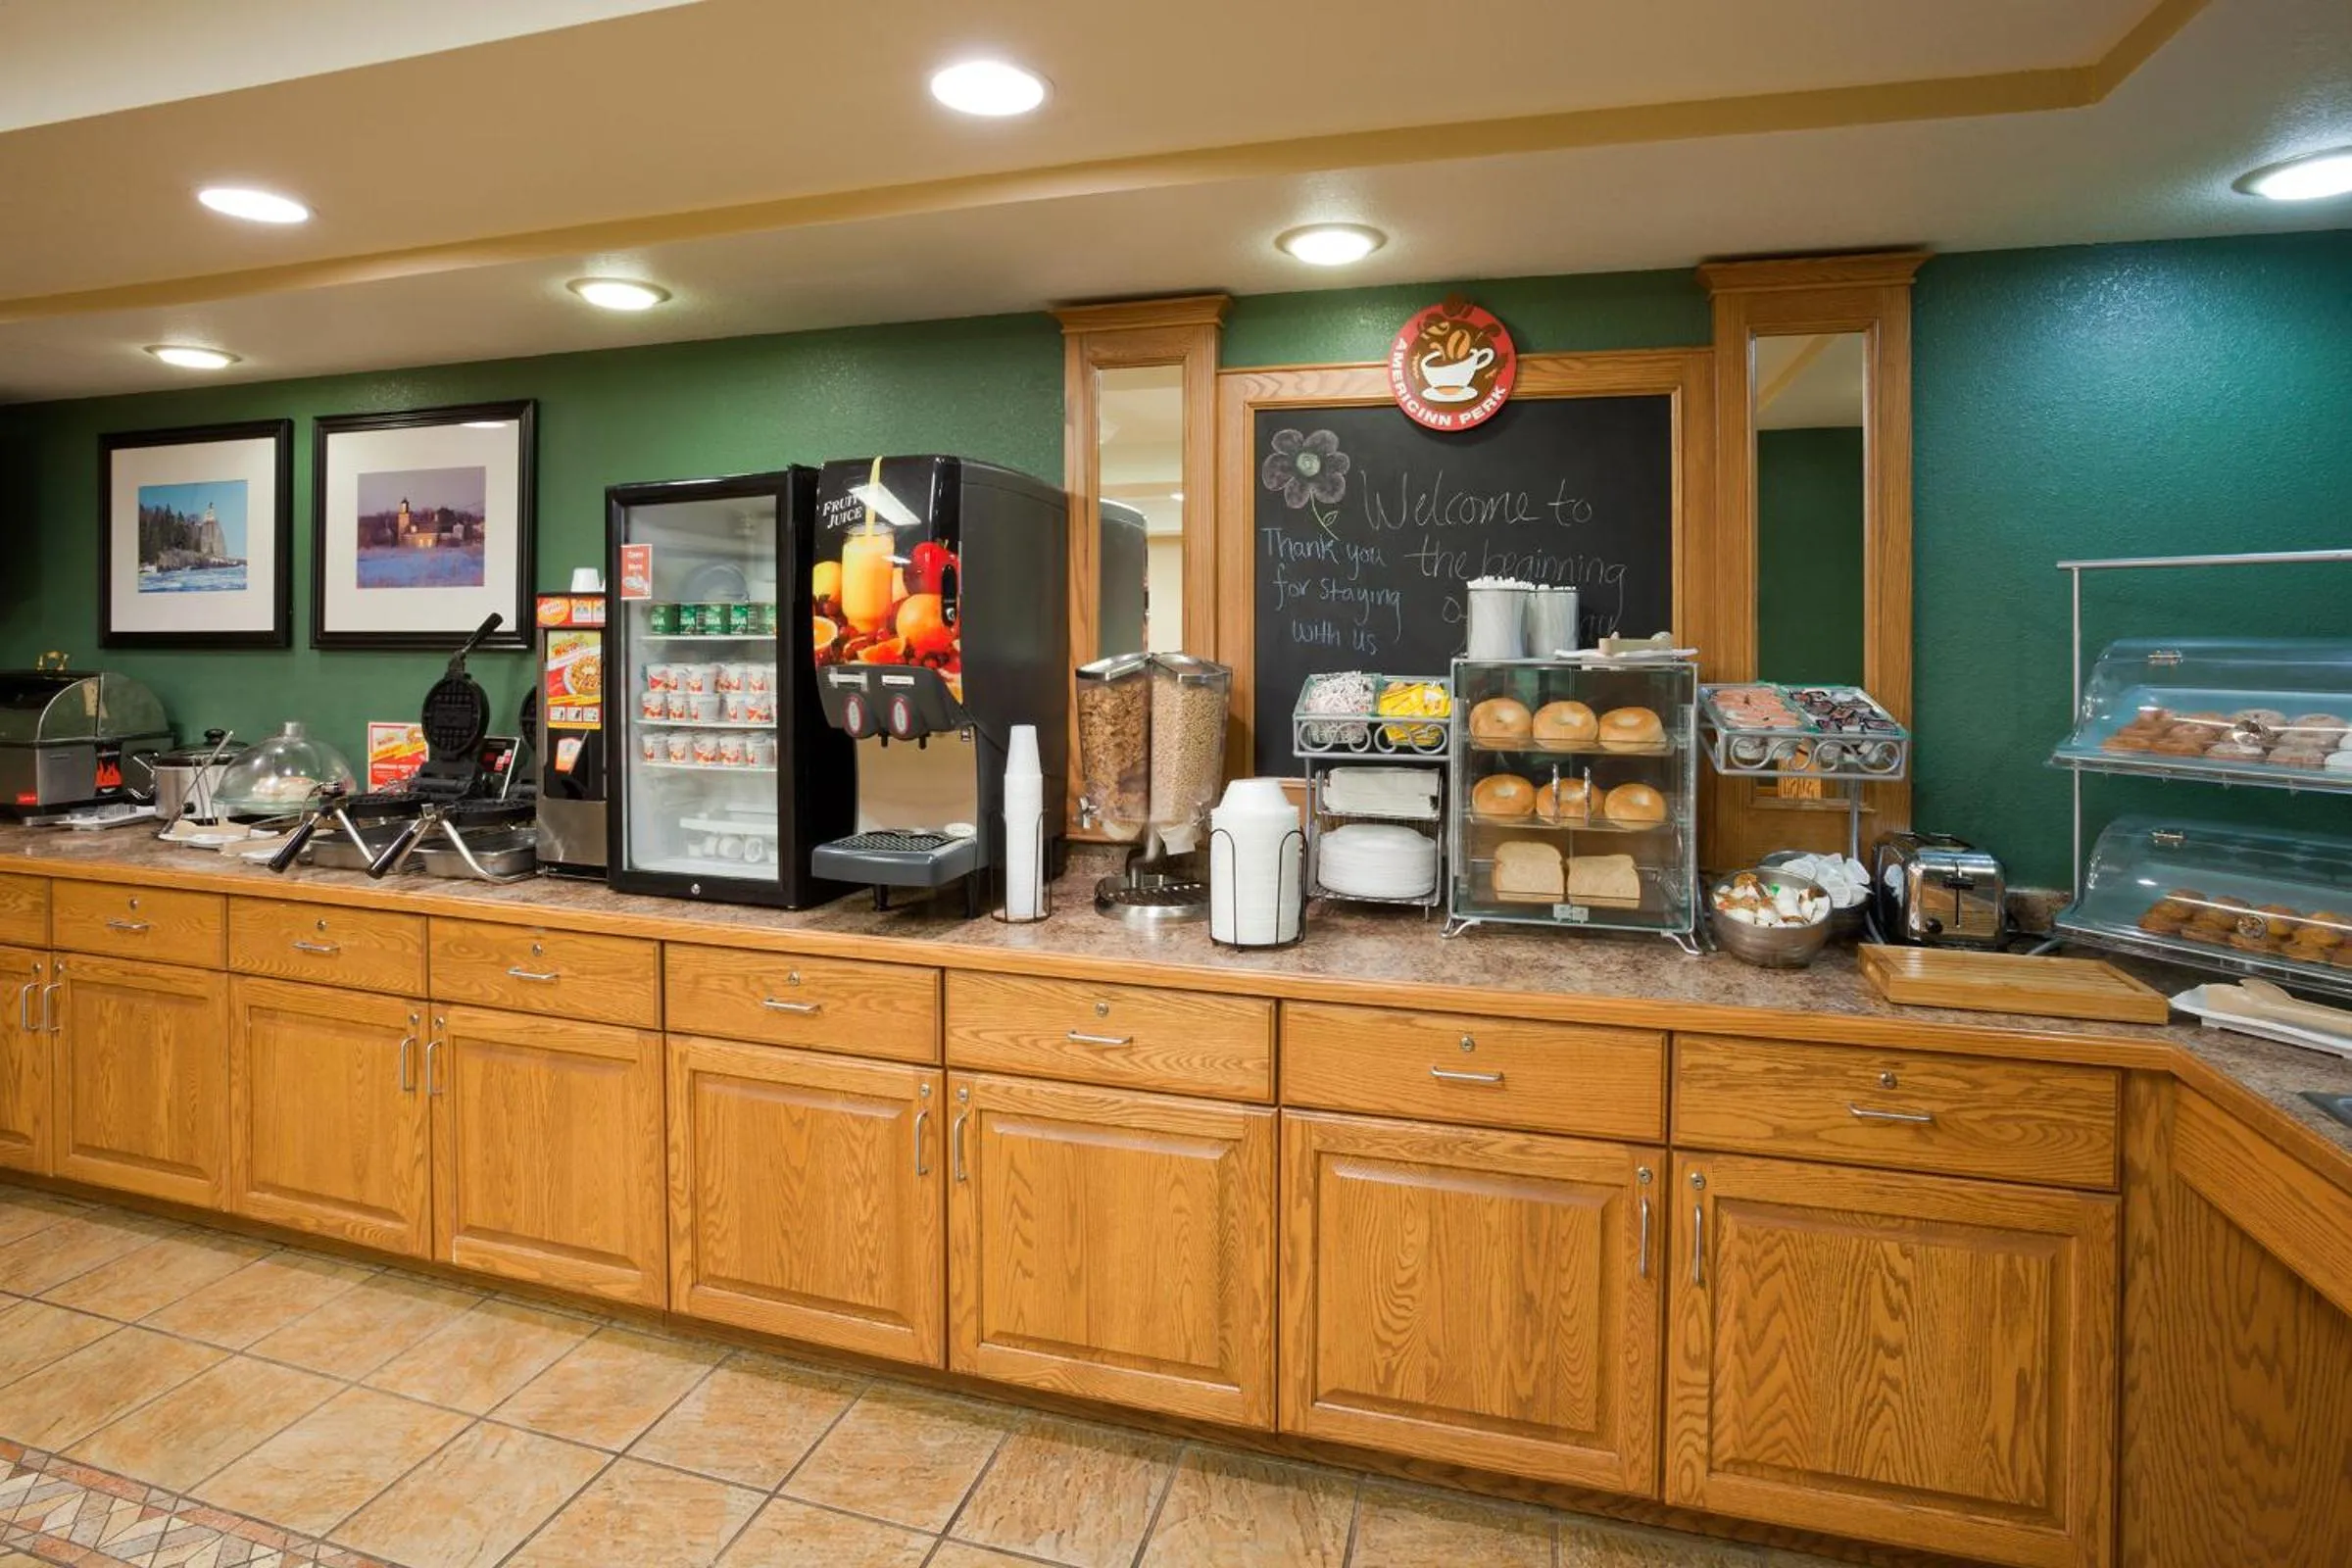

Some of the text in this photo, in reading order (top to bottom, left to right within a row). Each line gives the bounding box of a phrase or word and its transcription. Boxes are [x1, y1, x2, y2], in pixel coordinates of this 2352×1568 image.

[1392, 337, 1506, 425] AMERICINN PERK
[822, 493, 859, 516] FRUIT
[827, 506, 863, 529] JUICE
[1360, 469, 1592, 530] Welcome to
[1260, 527, 1388, 581] Thank you
[1403, 534, 1471, 581] the
[1271, 563, 1312, 612] for
[1352, 627, 1379, 656] us
